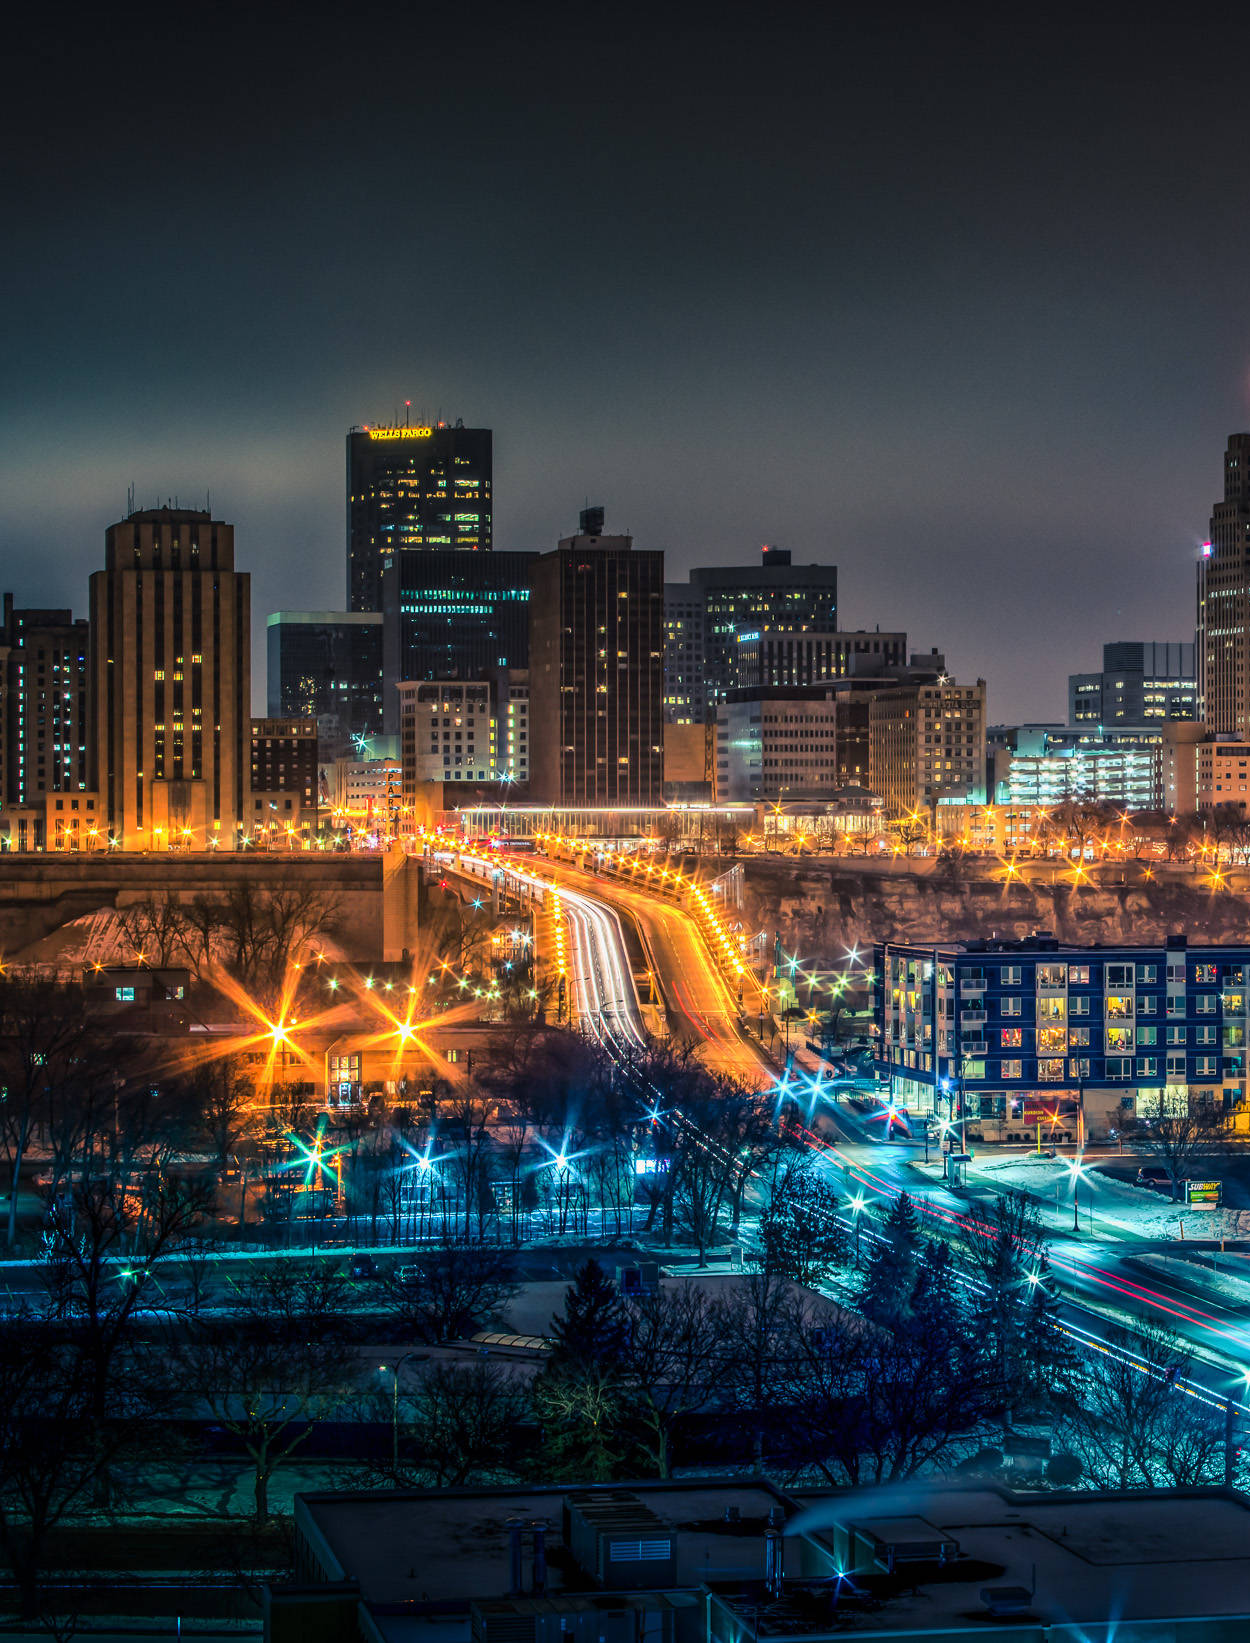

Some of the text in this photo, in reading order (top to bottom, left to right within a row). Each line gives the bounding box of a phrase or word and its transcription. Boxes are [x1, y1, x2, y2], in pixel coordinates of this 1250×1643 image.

[369, 428, 432, 440] WELLS FARGO
[1188, 1182, 1220, 1191] SUBWAY
